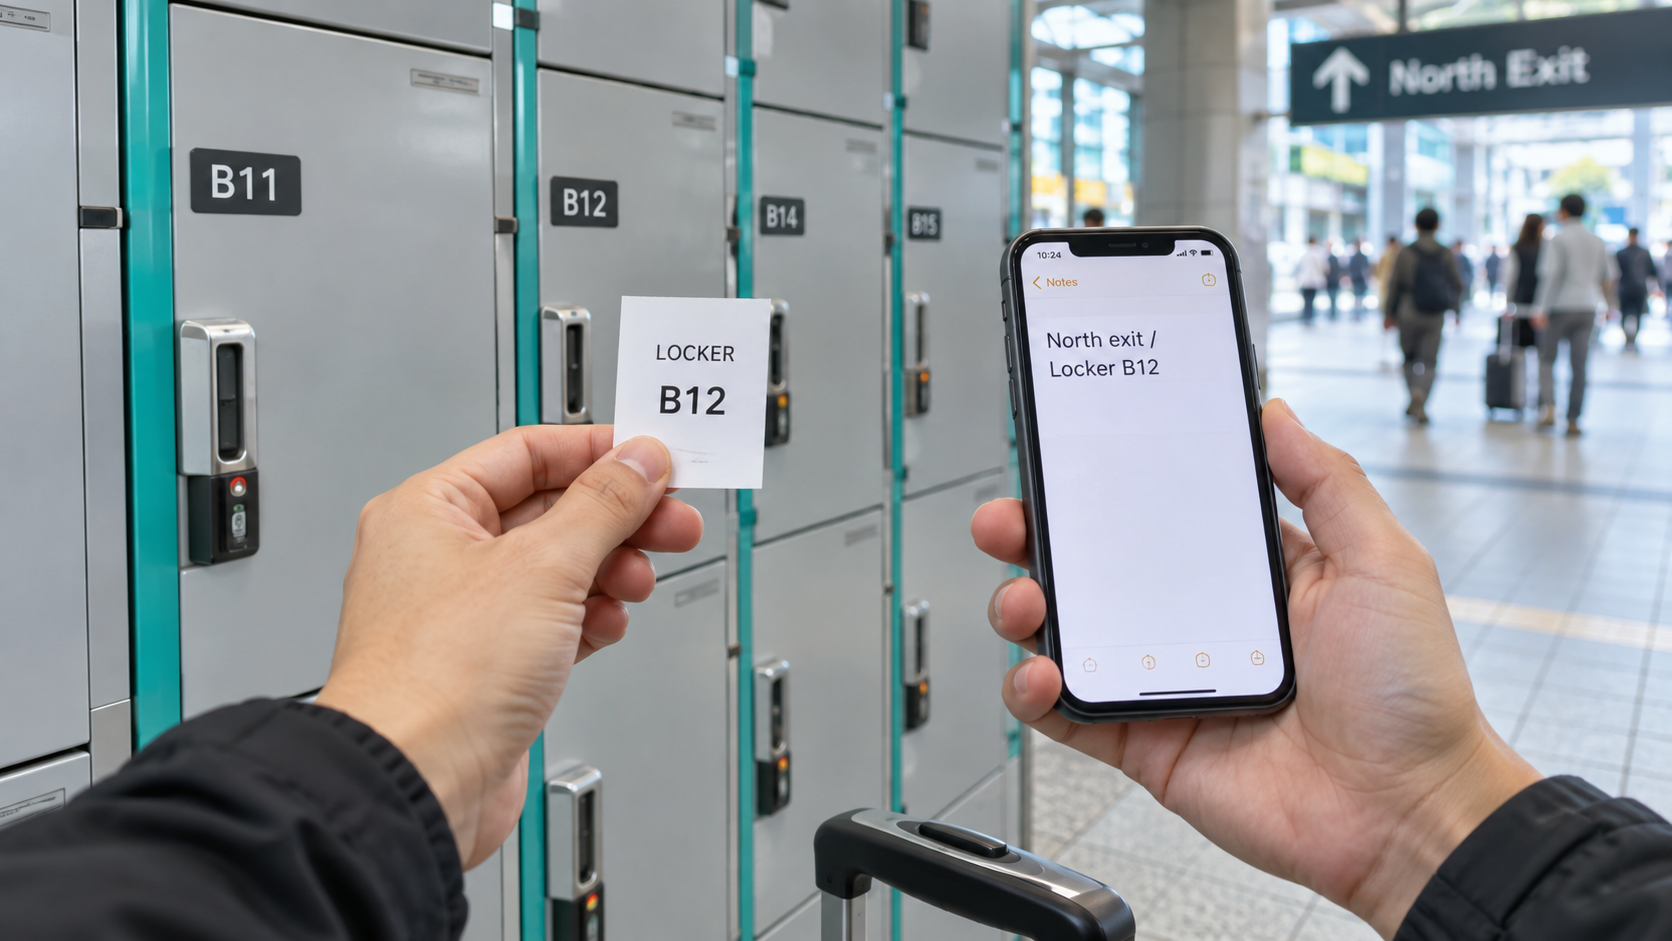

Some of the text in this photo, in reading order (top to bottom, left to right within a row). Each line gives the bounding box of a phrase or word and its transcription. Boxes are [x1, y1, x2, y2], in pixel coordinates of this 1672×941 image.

[1389, 46, 1589, 95] North Exit
[211, 164, 277, 202] B11
[563, 189, 607, 218] B12
[766, 205, 798, 229] B14
[912, 213, 938, 236] B15
[1037, 251, 1062, 260] 10:24
[1046, 277, 1078, 288] Notes
[1047, 330, 1157, 349] North exit /
[656, 344, 735, 362] LOCKER
[1050, 359, 1160, 378] Locker B12
[659, 385, 726, 415] B12
